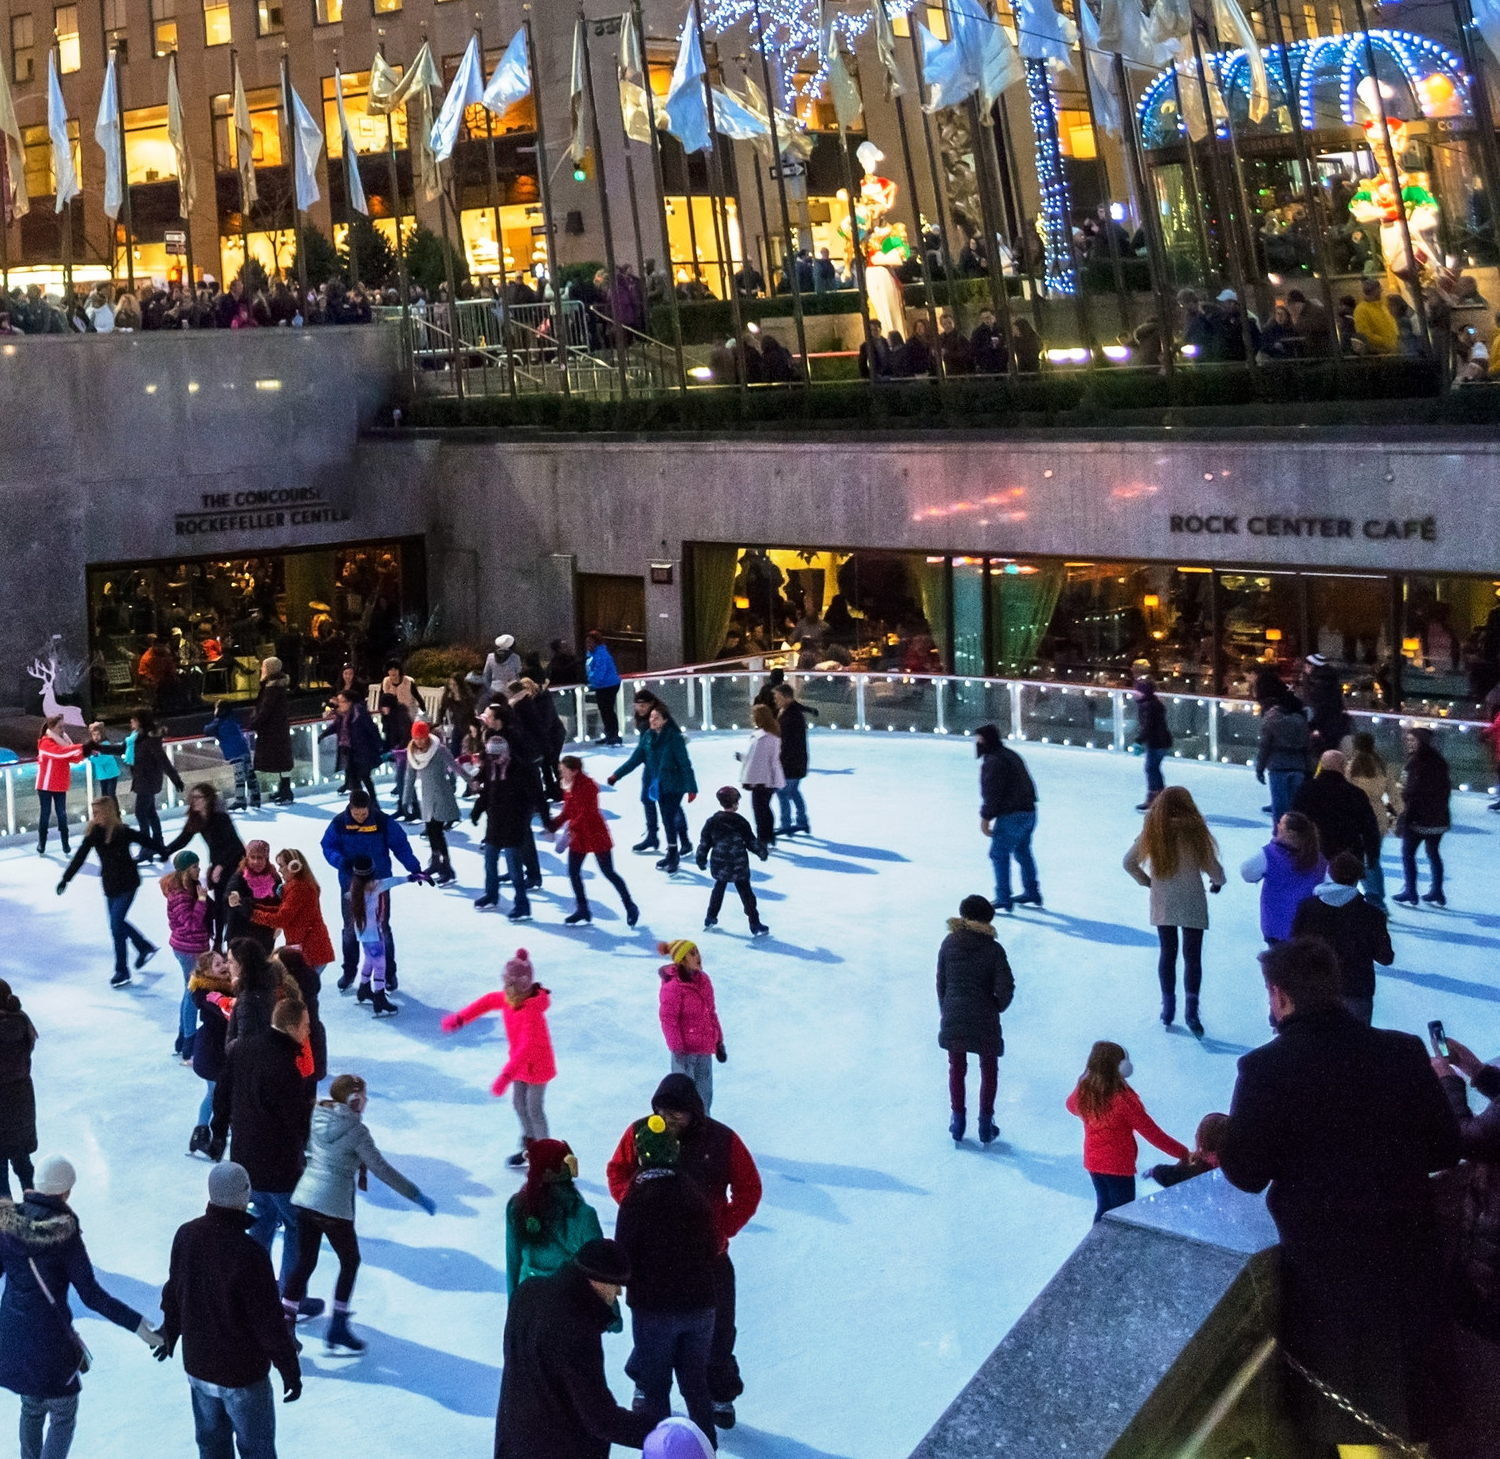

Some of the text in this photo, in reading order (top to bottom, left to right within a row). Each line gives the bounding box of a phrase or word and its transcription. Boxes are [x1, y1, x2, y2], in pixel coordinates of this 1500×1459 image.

[202, 493, 230, 508] THE
[174, 511, 285, 536] ROCKEFELLER
[1169, 514, 1438, 541] ROCK CENTER CAFÉ
